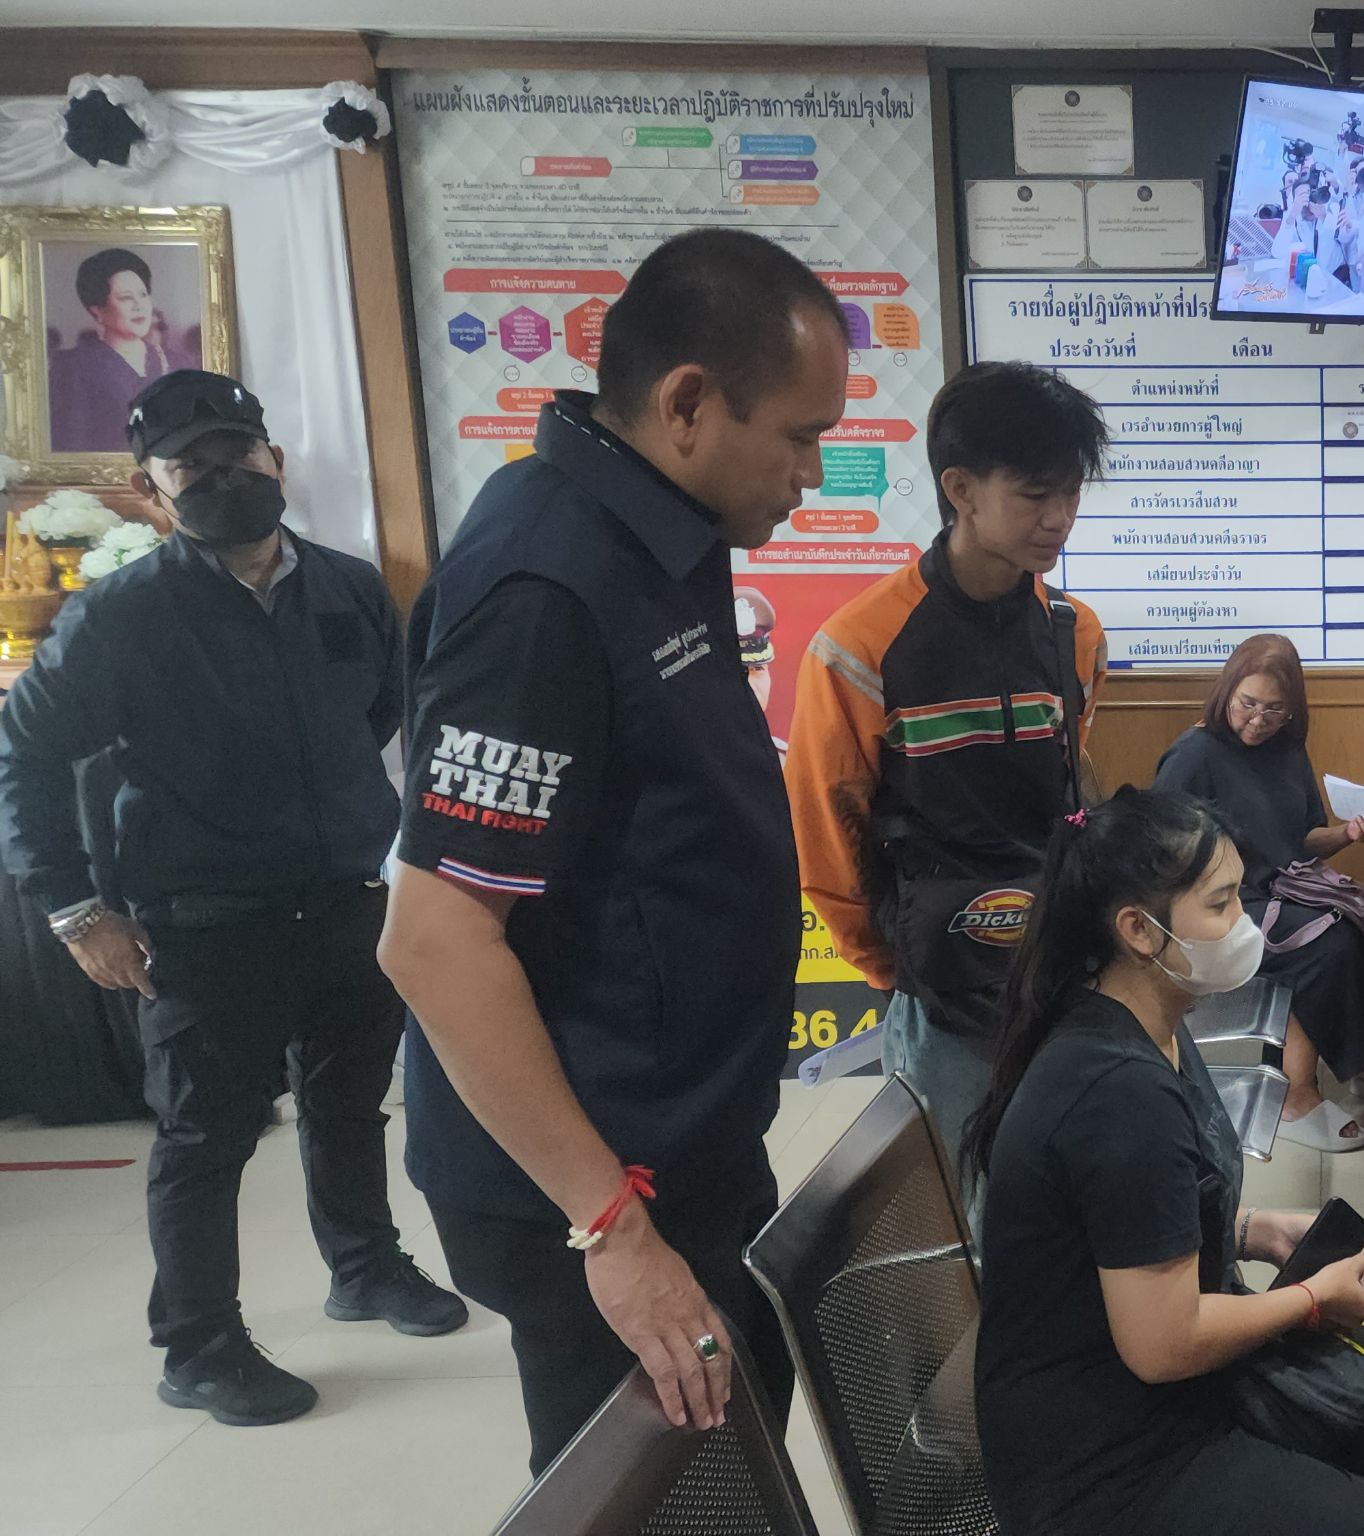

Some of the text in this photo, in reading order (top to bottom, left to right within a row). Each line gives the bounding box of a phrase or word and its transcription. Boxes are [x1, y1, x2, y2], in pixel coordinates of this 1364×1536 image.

[1050, 333, 1137, 358] ประจำวันที่
[1232, 336, 1273, 358] เดือน
[1131, 373, 1220, 396] ตำแหน่งหน้าที่
[1121, 414, 1243, 439] เวรอำนวยการผู้ใหญ่
[1108, 454, 1260, 474] พนักงานสอบสวนคดีอาญา
[1130, 490, 1238, 509] สารวัตรเวรสืบสวน
[1112, 528, 1268, 545] พนักงานสอบสวนคดีจราจร
[1147, 565, 1242, 582] เสมียนประจำวัน
[1146, 601, 1238, 623] ควบคุมผู้ต้องหา
[433, 724, 573, 786] MUAY
[429, 759, 558, 819] THAI
[421, 792, 549, 835] THAI FIGHT
